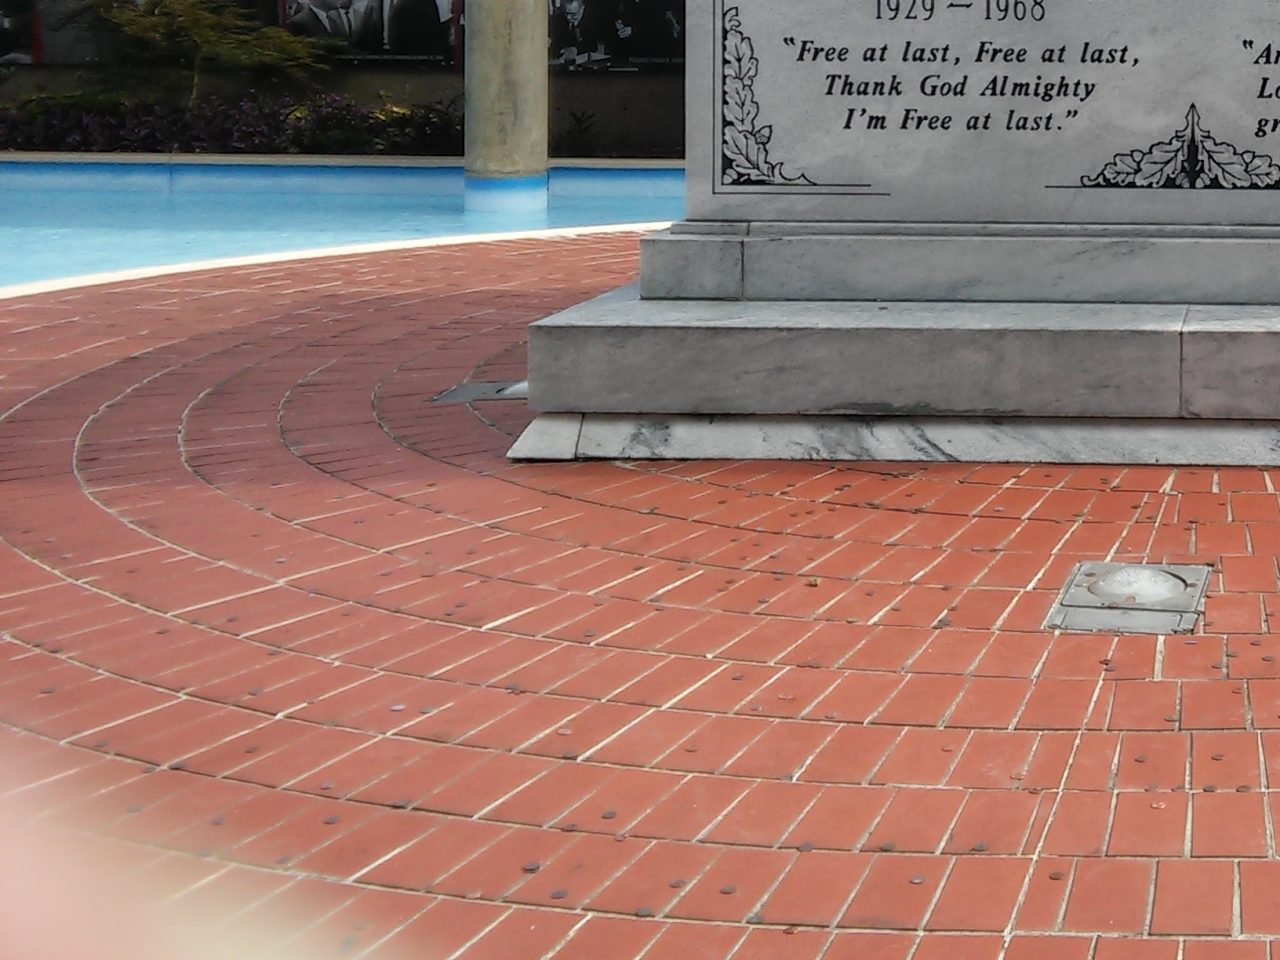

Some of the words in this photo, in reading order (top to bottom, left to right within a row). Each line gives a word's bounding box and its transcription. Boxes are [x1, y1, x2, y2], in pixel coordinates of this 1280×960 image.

[862, 43, 889, 63] at
[901, 40, 961, 66] last,
[974, 41, 1028, 64] Free
[1040, 44, 1067, 64] at
[1079, 41, 1140, 68] last,
[824, 73, 903, 97] Thank
[919, 74, 969, 97] God
[979, 74, 1097, 103] Almighty
[899, 108, 953, 131] Free
[965, 112, 992, 131] at
